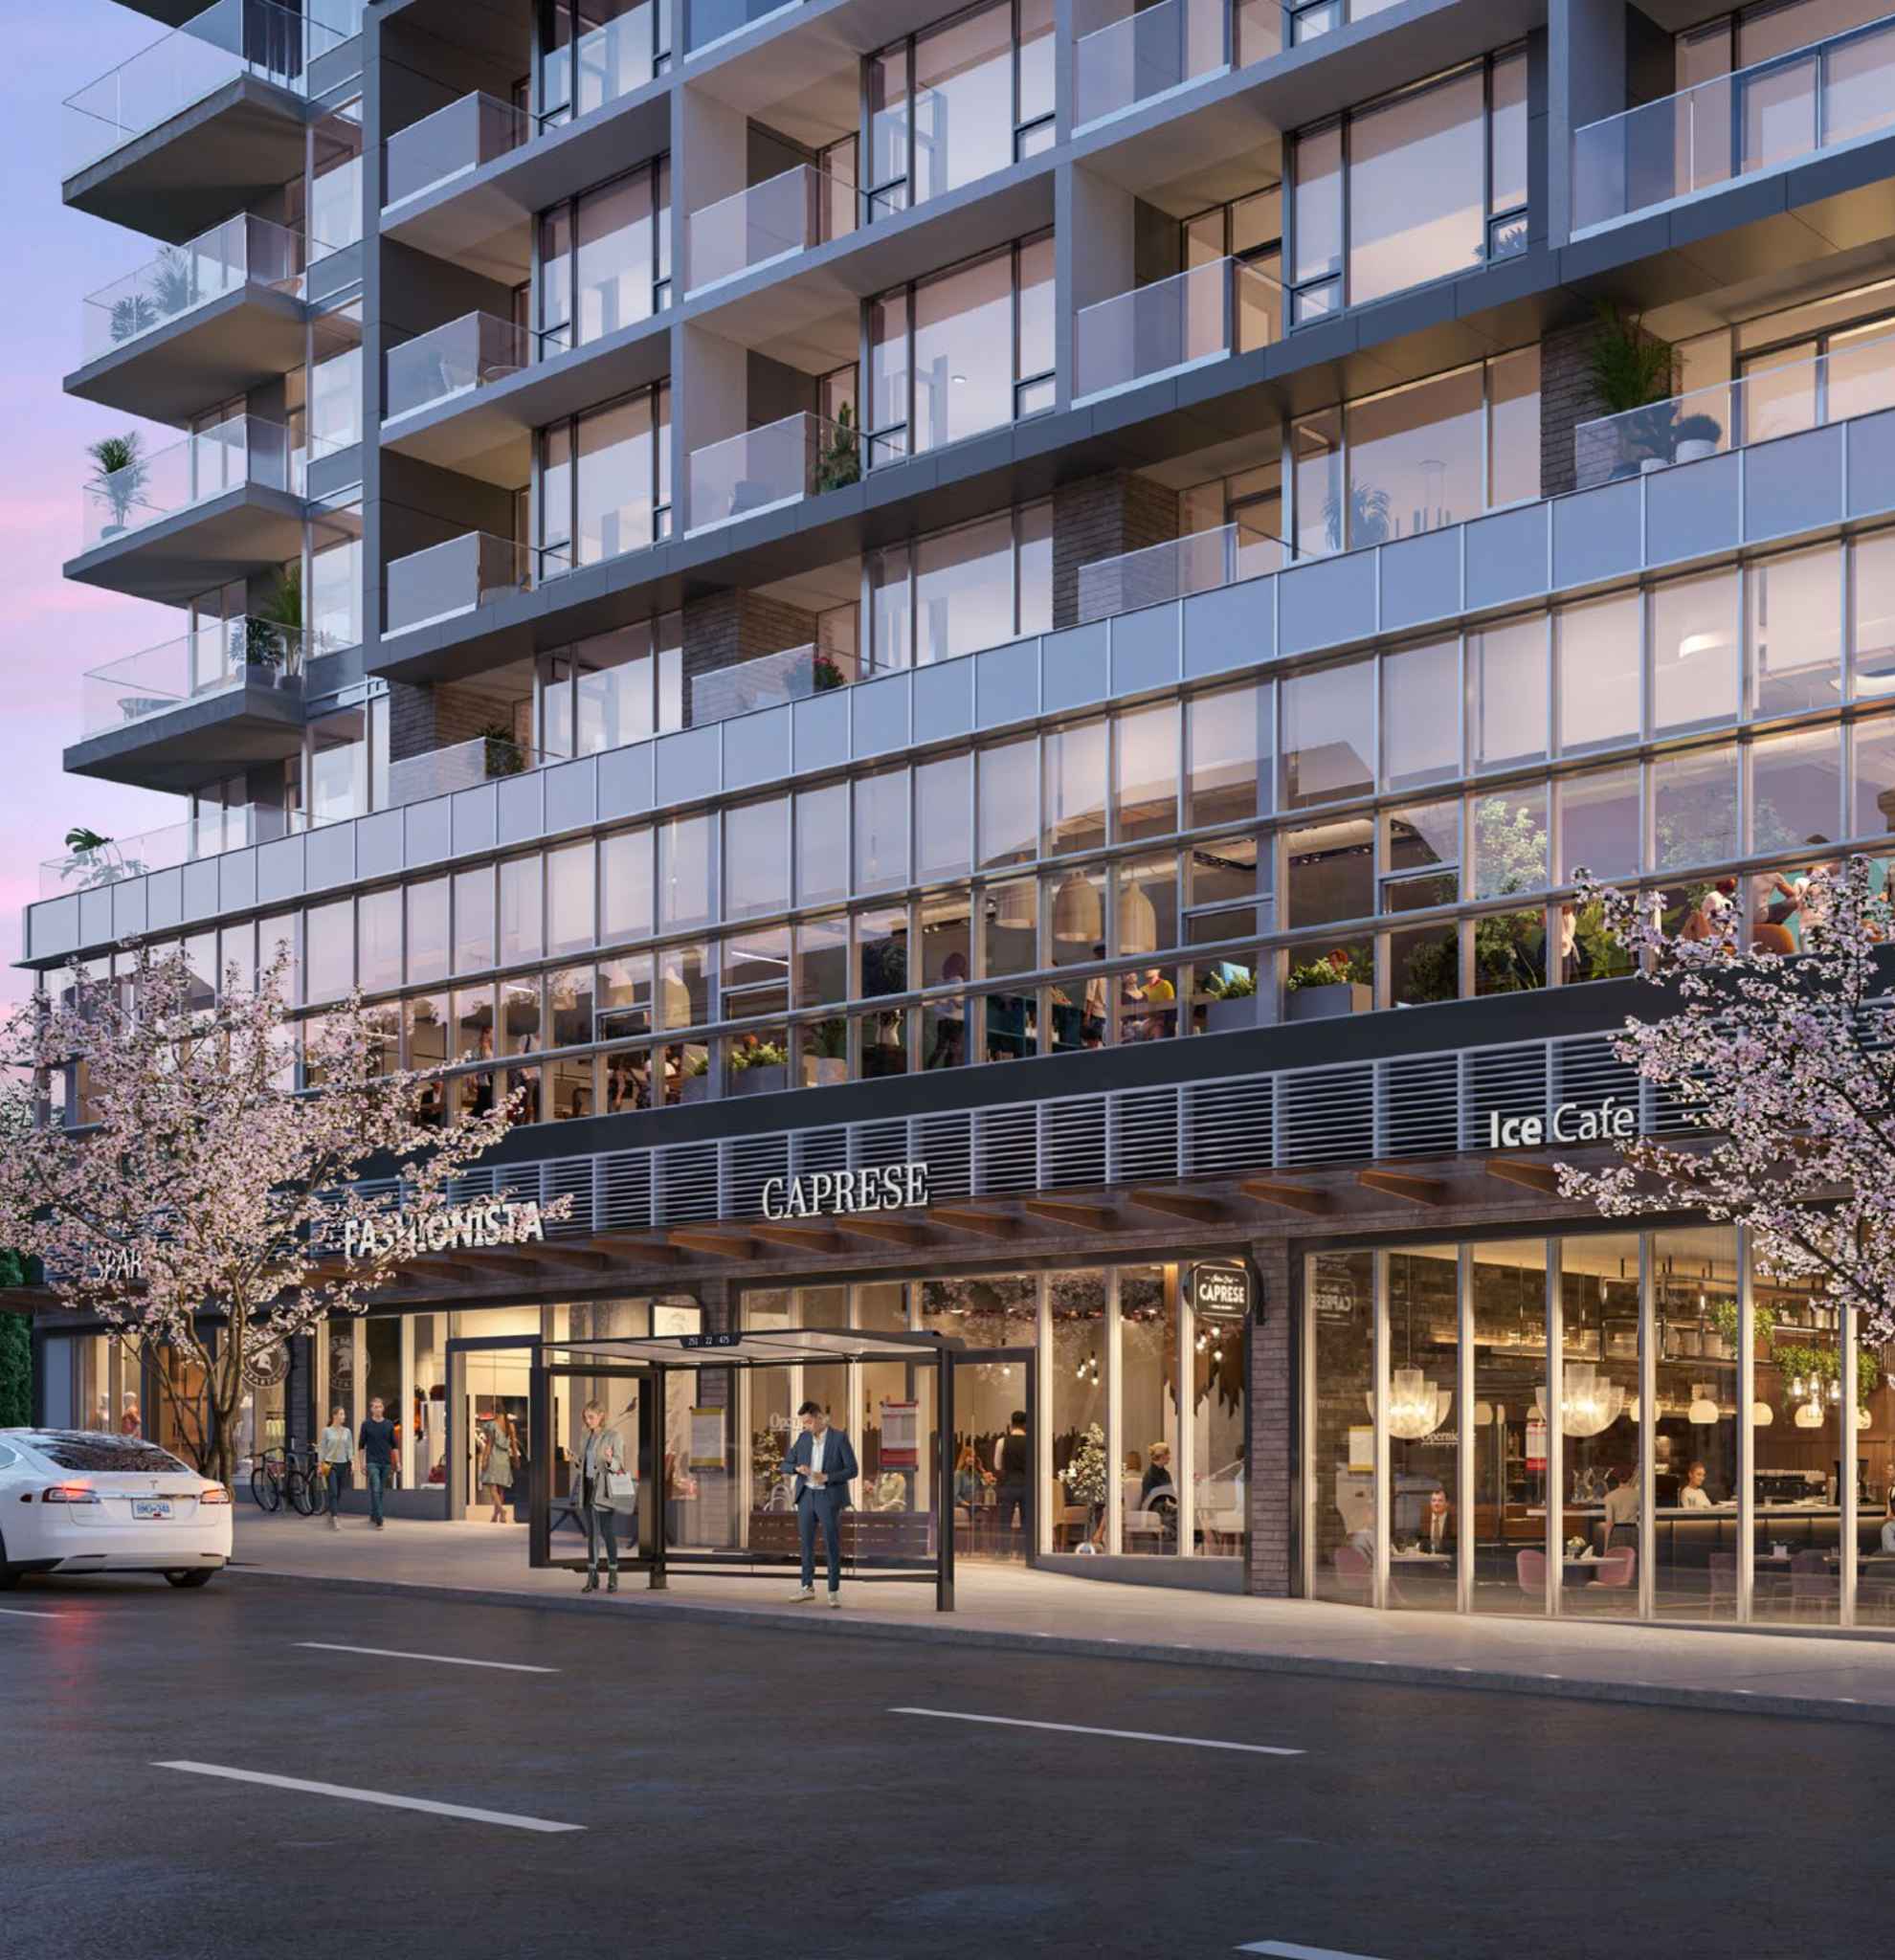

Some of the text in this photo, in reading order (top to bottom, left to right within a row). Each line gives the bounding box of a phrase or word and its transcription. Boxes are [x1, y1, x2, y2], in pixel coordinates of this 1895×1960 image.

[1489, 1110, 1543, 1148] Ice
[762, 1163, 929, 1220] CAPRESE
[1199, 1283, 1245, 1303] CAPRESE
